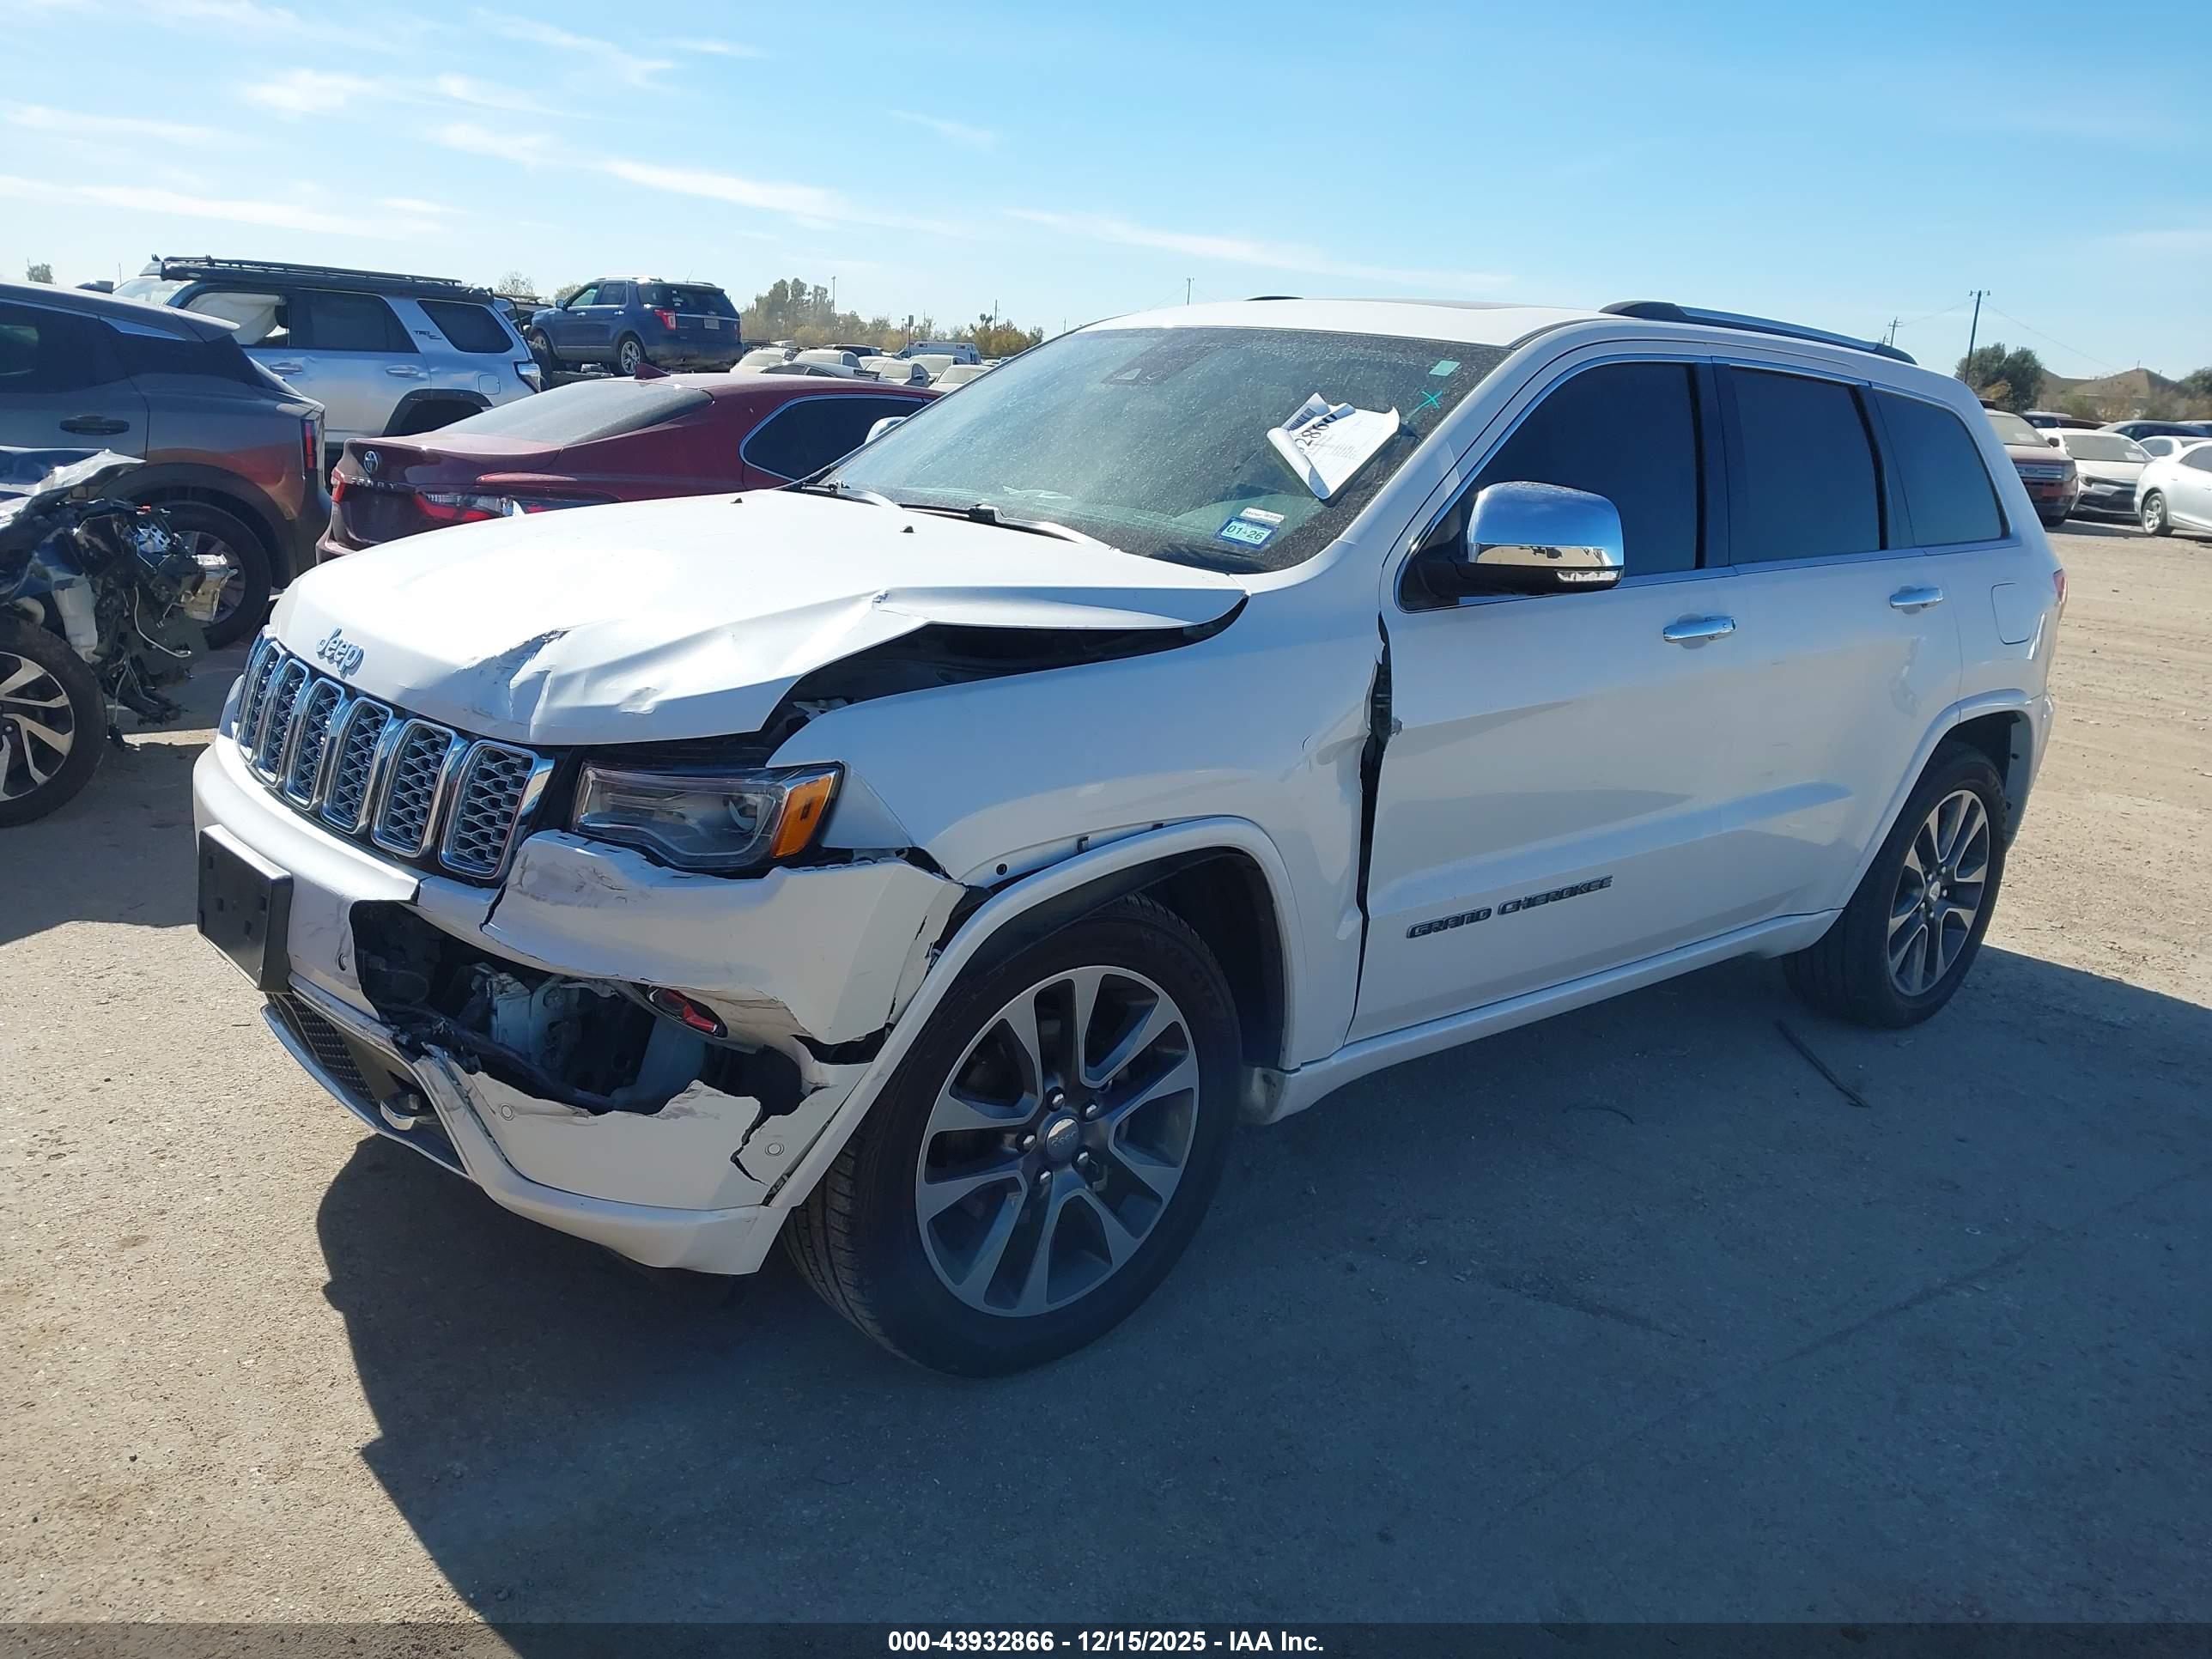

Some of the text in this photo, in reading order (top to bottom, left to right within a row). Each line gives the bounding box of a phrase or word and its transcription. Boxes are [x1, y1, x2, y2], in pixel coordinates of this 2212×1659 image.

[316, 628, 364, 679] Jeep
[1406, 875, 1613, 939] GRAND CHEROKEE
